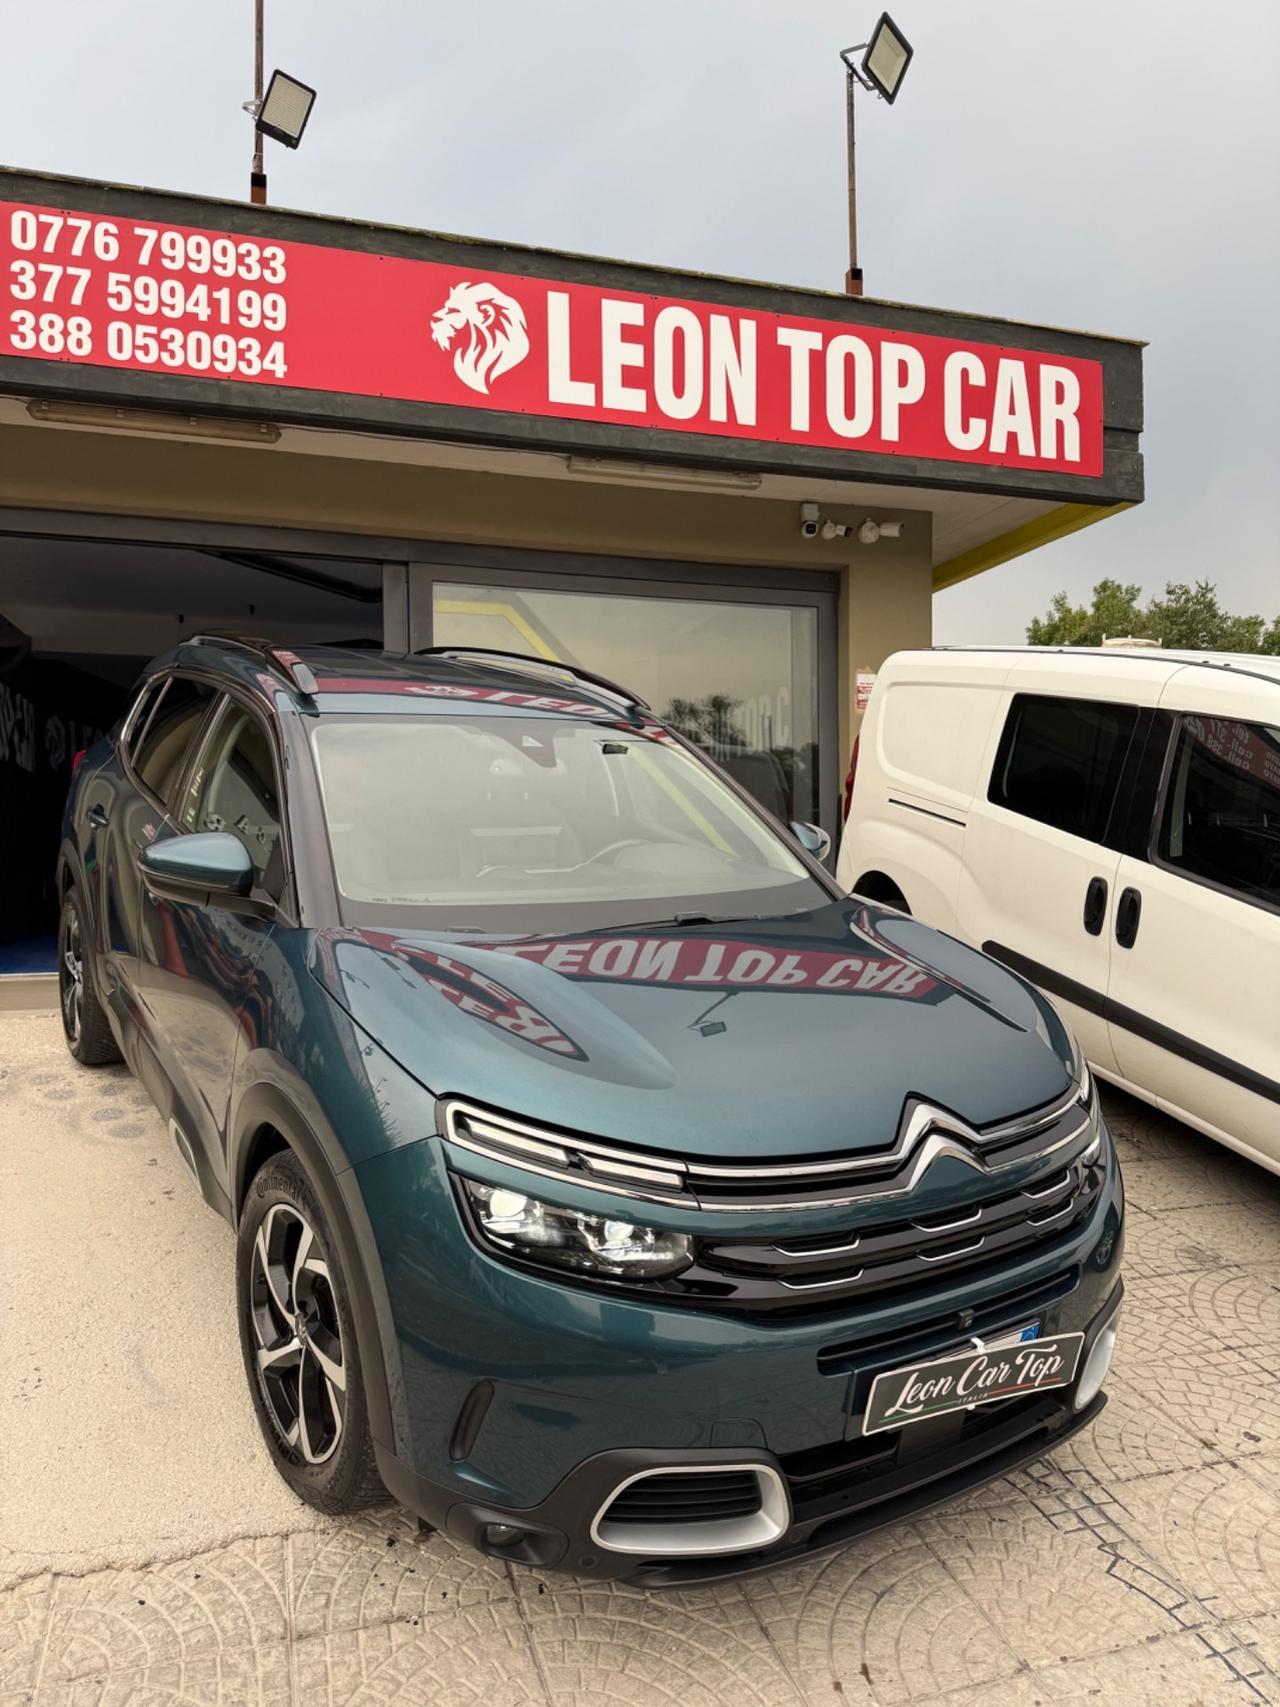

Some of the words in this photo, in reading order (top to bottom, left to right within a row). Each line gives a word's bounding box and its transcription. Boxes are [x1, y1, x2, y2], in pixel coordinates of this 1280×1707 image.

[10, 209, 120, 262] 0776
[133, 226, 287, 285] 799933
[9, 259, 92, 306] 377
[106, 271, 287, 332] 5994199
[9, 309, 93, 357] 388
[107, 320, 288, 379] 0530934
[546, 290, 704, 427] LEON
[776, 326, 927, 442] TOP
[943, 350, 1081, 480] CAR
[883, 1371, 957, 1417] Leon
[957, 1355, 1012, 1395] Car
[1014, 1343, 1066, 1388] Top
